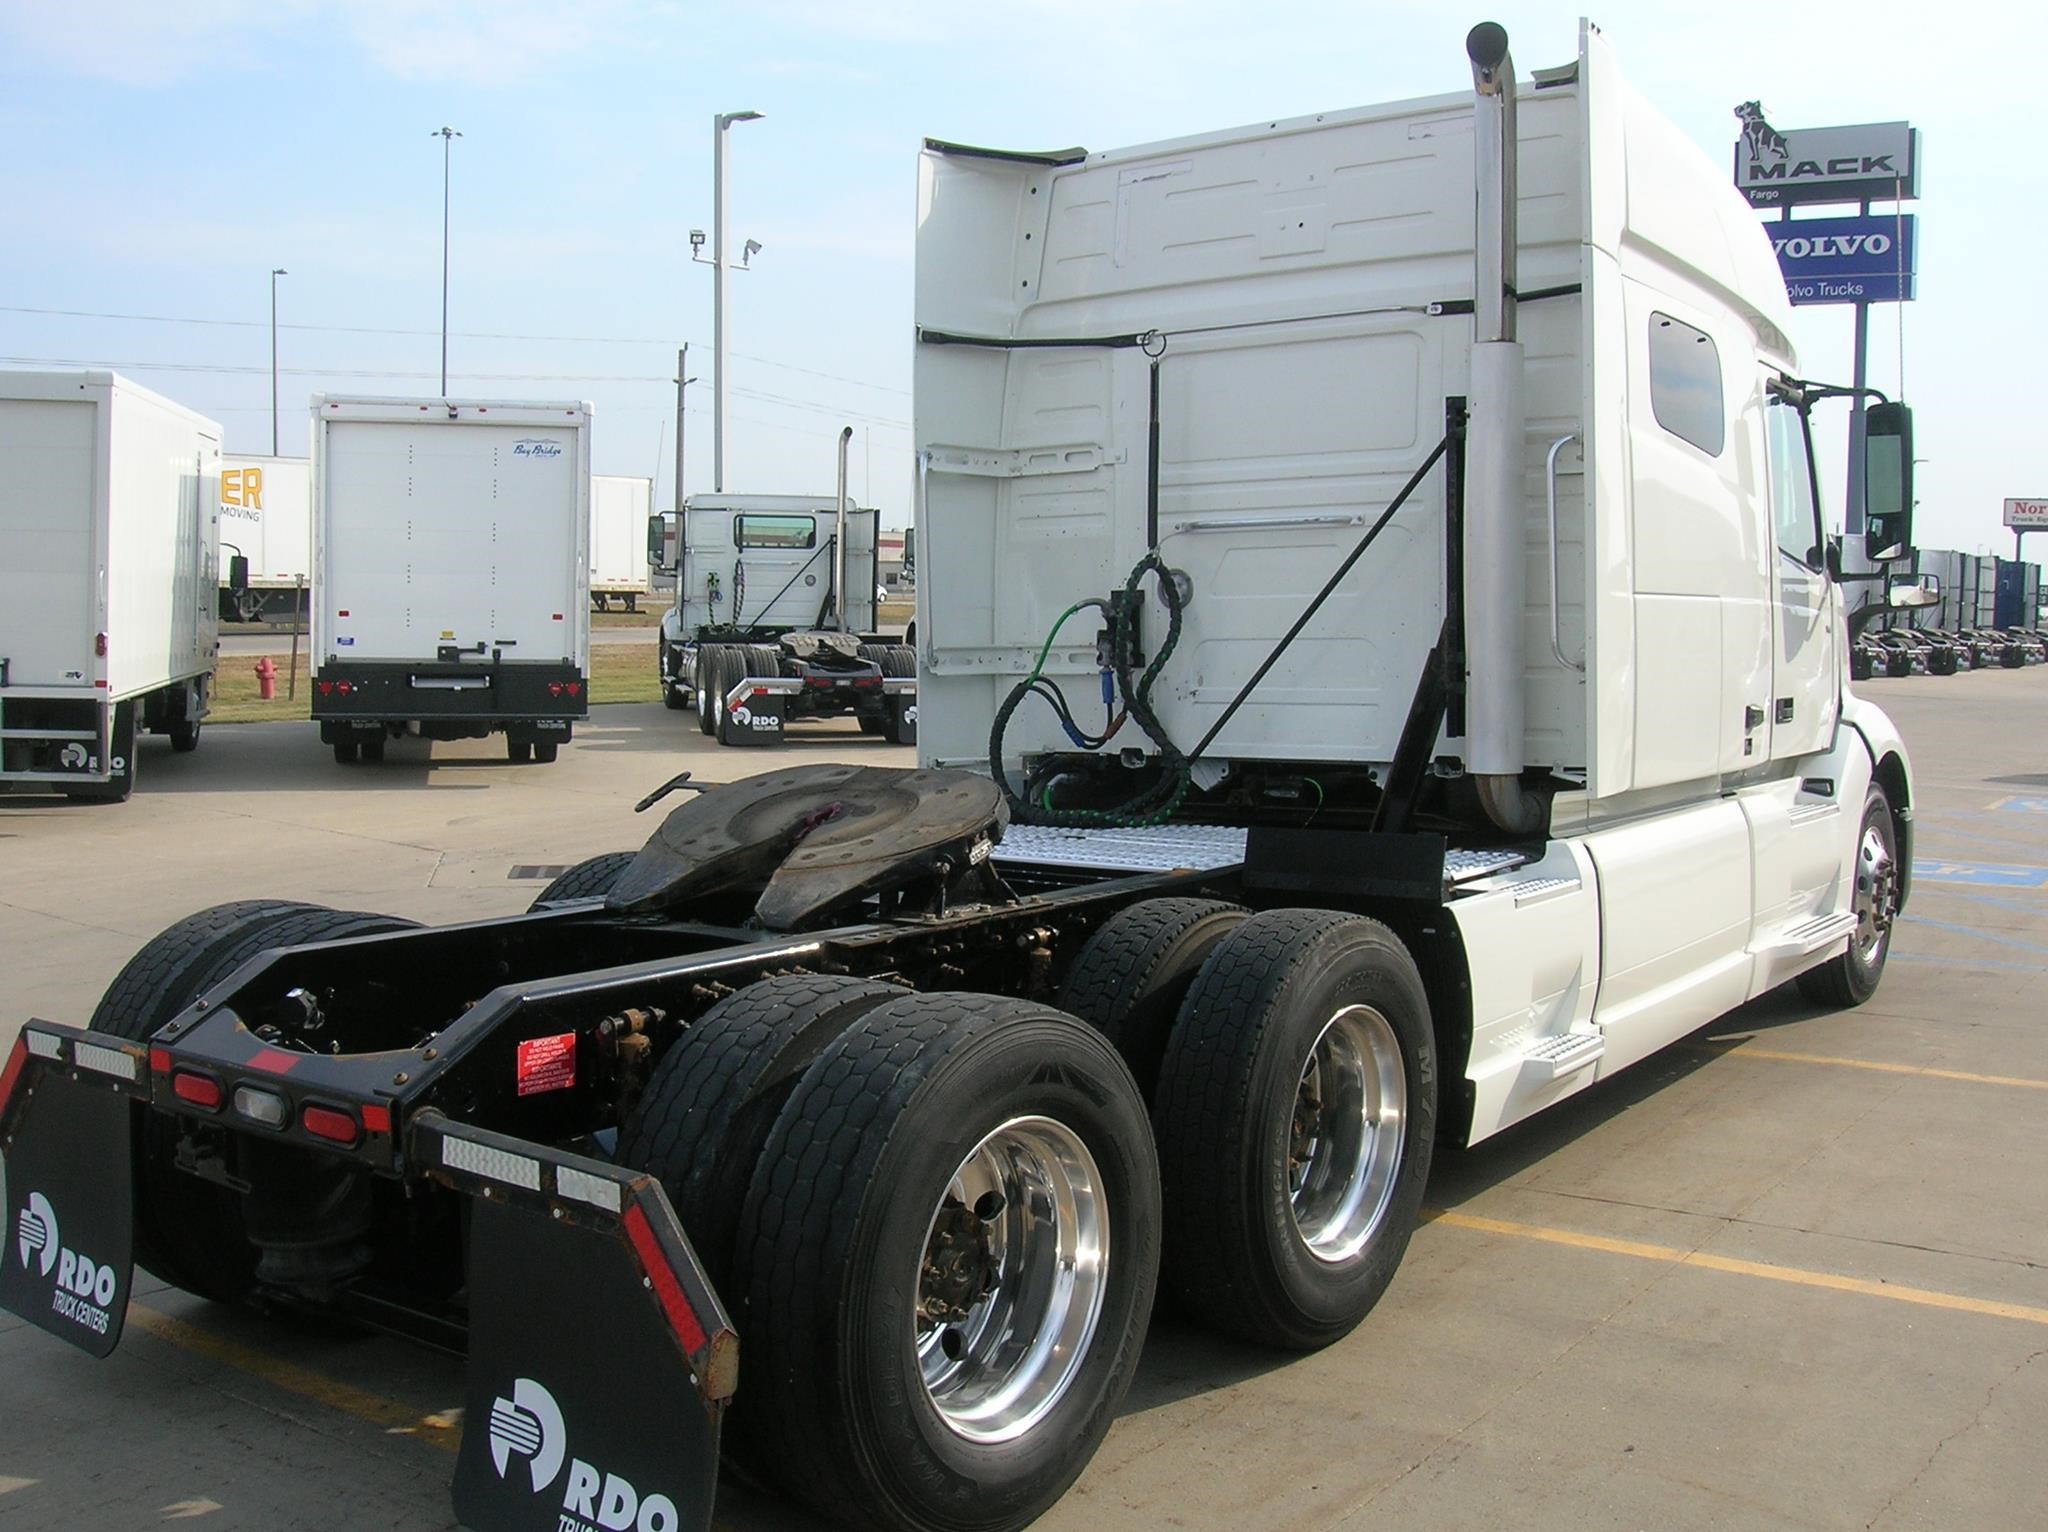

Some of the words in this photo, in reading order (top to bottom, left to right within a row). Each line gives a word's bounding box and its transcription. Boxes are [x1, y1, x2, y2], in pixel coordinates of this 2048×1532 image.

[1750, 155, 1894, 181] MACK
[1750, 189, 1779, 200] Fargo
[1786, 284, 1814, 297] olvo
[1817, 282, 1863, 297] Trucks
[220, 506, 260, 522] MOVING
[753, 716, 779, 725] RDO
[89, 756, 125, 769] RO
[57, 1247, 116, 1307] RDO
[52, 1290, 77, 1319] TRUCK
[76, 1301, 110, 1335] CENTERS
[563, 1457, 679, 1532] RDO
